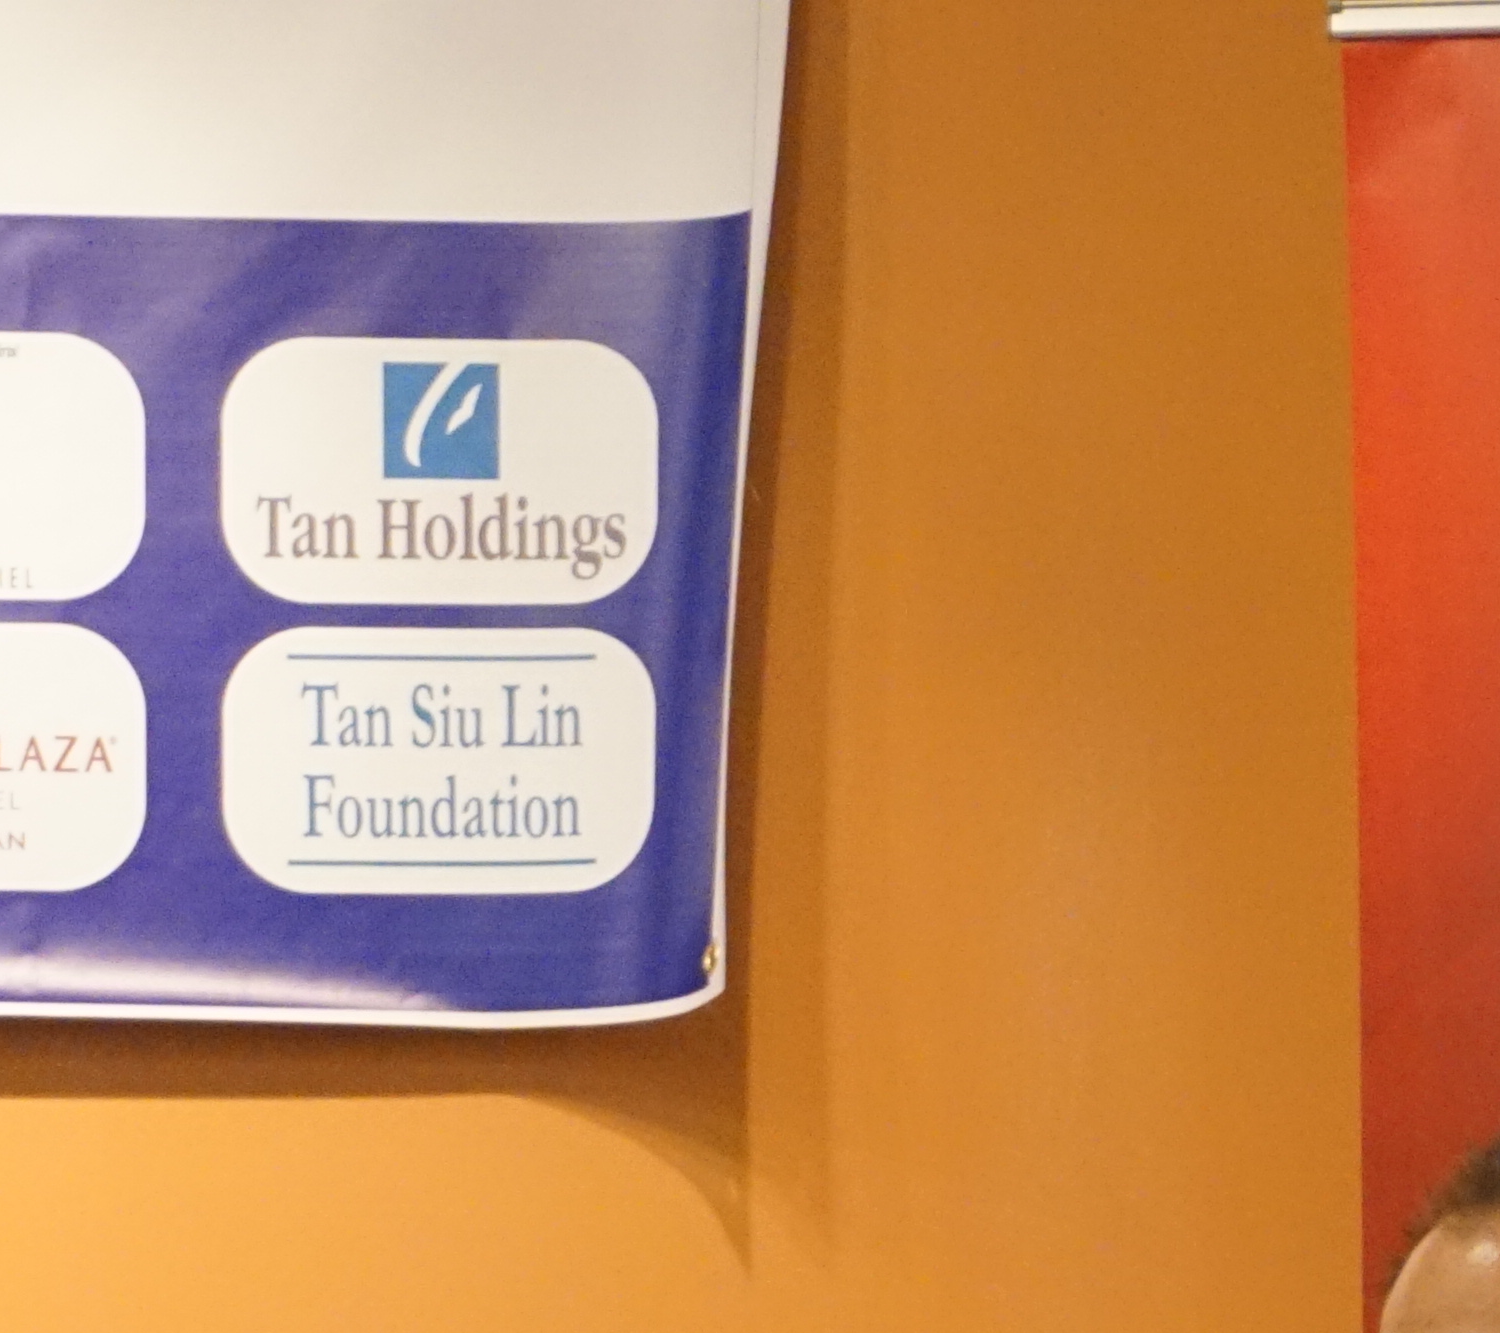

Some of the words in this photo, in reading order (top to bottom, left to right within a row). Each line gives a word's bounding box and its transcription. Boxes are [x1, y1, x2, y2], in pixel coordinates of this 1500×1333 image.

[256, 493, 358, 560] Tan
[376, 492, 629, 581] Holdings
[301, 682, 394, 748] Tan
[411, 682, 485, 749] Siu
[500, 683, 584, 748] Lin
[302, 773, 583, 839] Foundation
